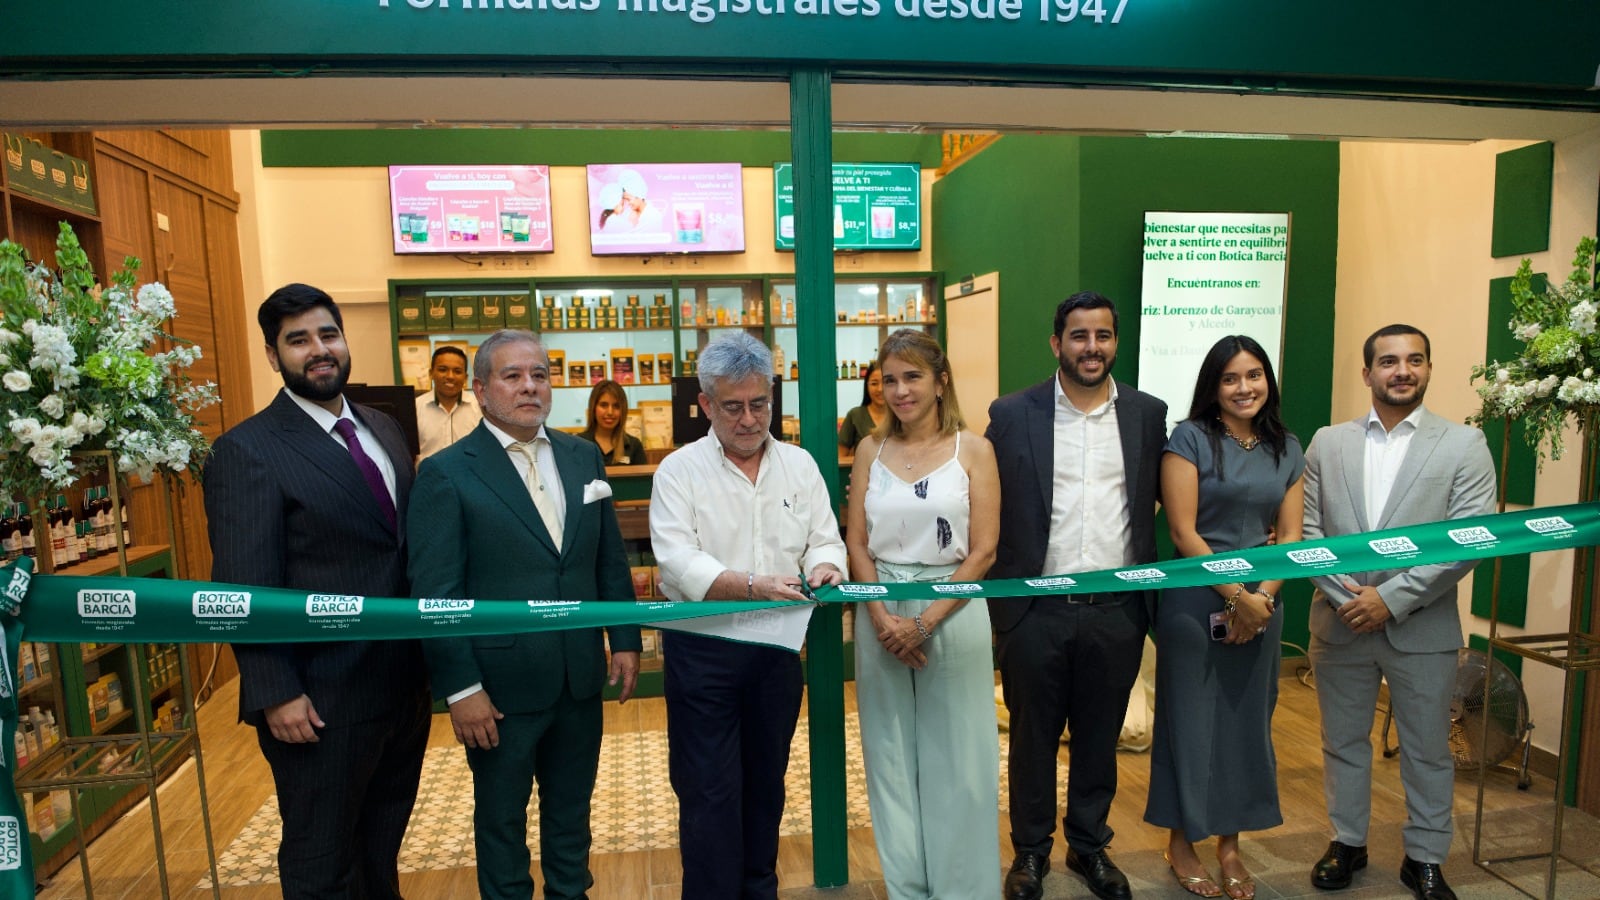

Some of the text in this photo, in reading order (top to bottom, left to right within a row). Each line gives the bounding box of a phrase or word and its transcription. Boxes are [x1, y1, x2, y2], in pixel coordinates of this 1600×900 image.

[1039, 0, 1128, 23] 1947
[1144, 222, 1196, 233] bienestar
[1198, 225, 1218, 236] que
[1221, 224, 1271, 234] necesitas
[1179, 238, 1222, 247] sentirte
[1240, 237, 1288, 249] equilibri
[1143, 250, 1174, 261] uelve
[1176, 253, 1183, 261] a
[1186, 250, 1194, 261] ti
[1196, 253, 1216, 261] con
[1219, 250, 1253, 261] Botica
[1168, 277, 1260, 288] Encuéntranos en:
[1141, 305, 1161, 316] riz:
[1164, 305, 1208, 316] Lorenzo
[1210, 305, 1223, 316] de
[1226, 305, 1276, 318] Garaycoa
[1198, 319, 1236, 329] Alcedo
[1529, 518, 1562, 528] BOTICA
[1452, 528, 1488, 538] BOTICA
[1373, 538, 1409, 548] BOTICA
[1291, 549, 1328, 558] BOTICA
[83, 592, 131, 603] BOTICA
[198, 594, 246, 603] BOTICA
[84, 604, 132, 614] BARCIA
[198, 604, 246, 614] BARCIA
[312, 603, 358, 612] BARCIA
[424, 600, 470, 609] BARCIA
[7, 821, 18, 865] BOTICA
